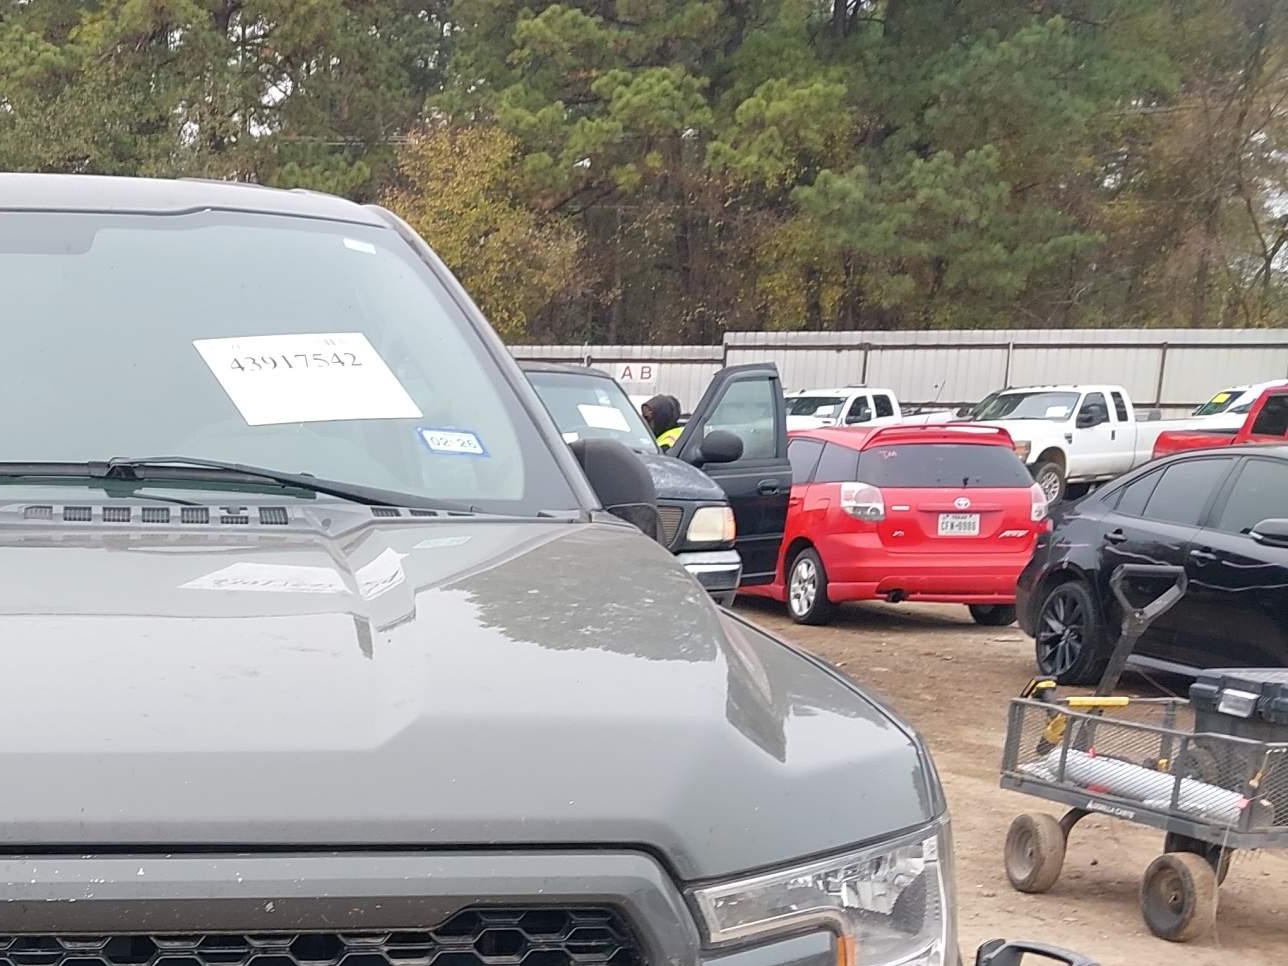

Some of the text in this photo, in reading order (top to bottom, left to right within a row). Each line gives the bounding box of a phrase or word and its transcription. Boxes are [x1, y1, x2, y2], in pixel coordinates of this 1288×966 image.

[230, 352, 363, 372] 43917542
[620, 365, 652, 380] A B
